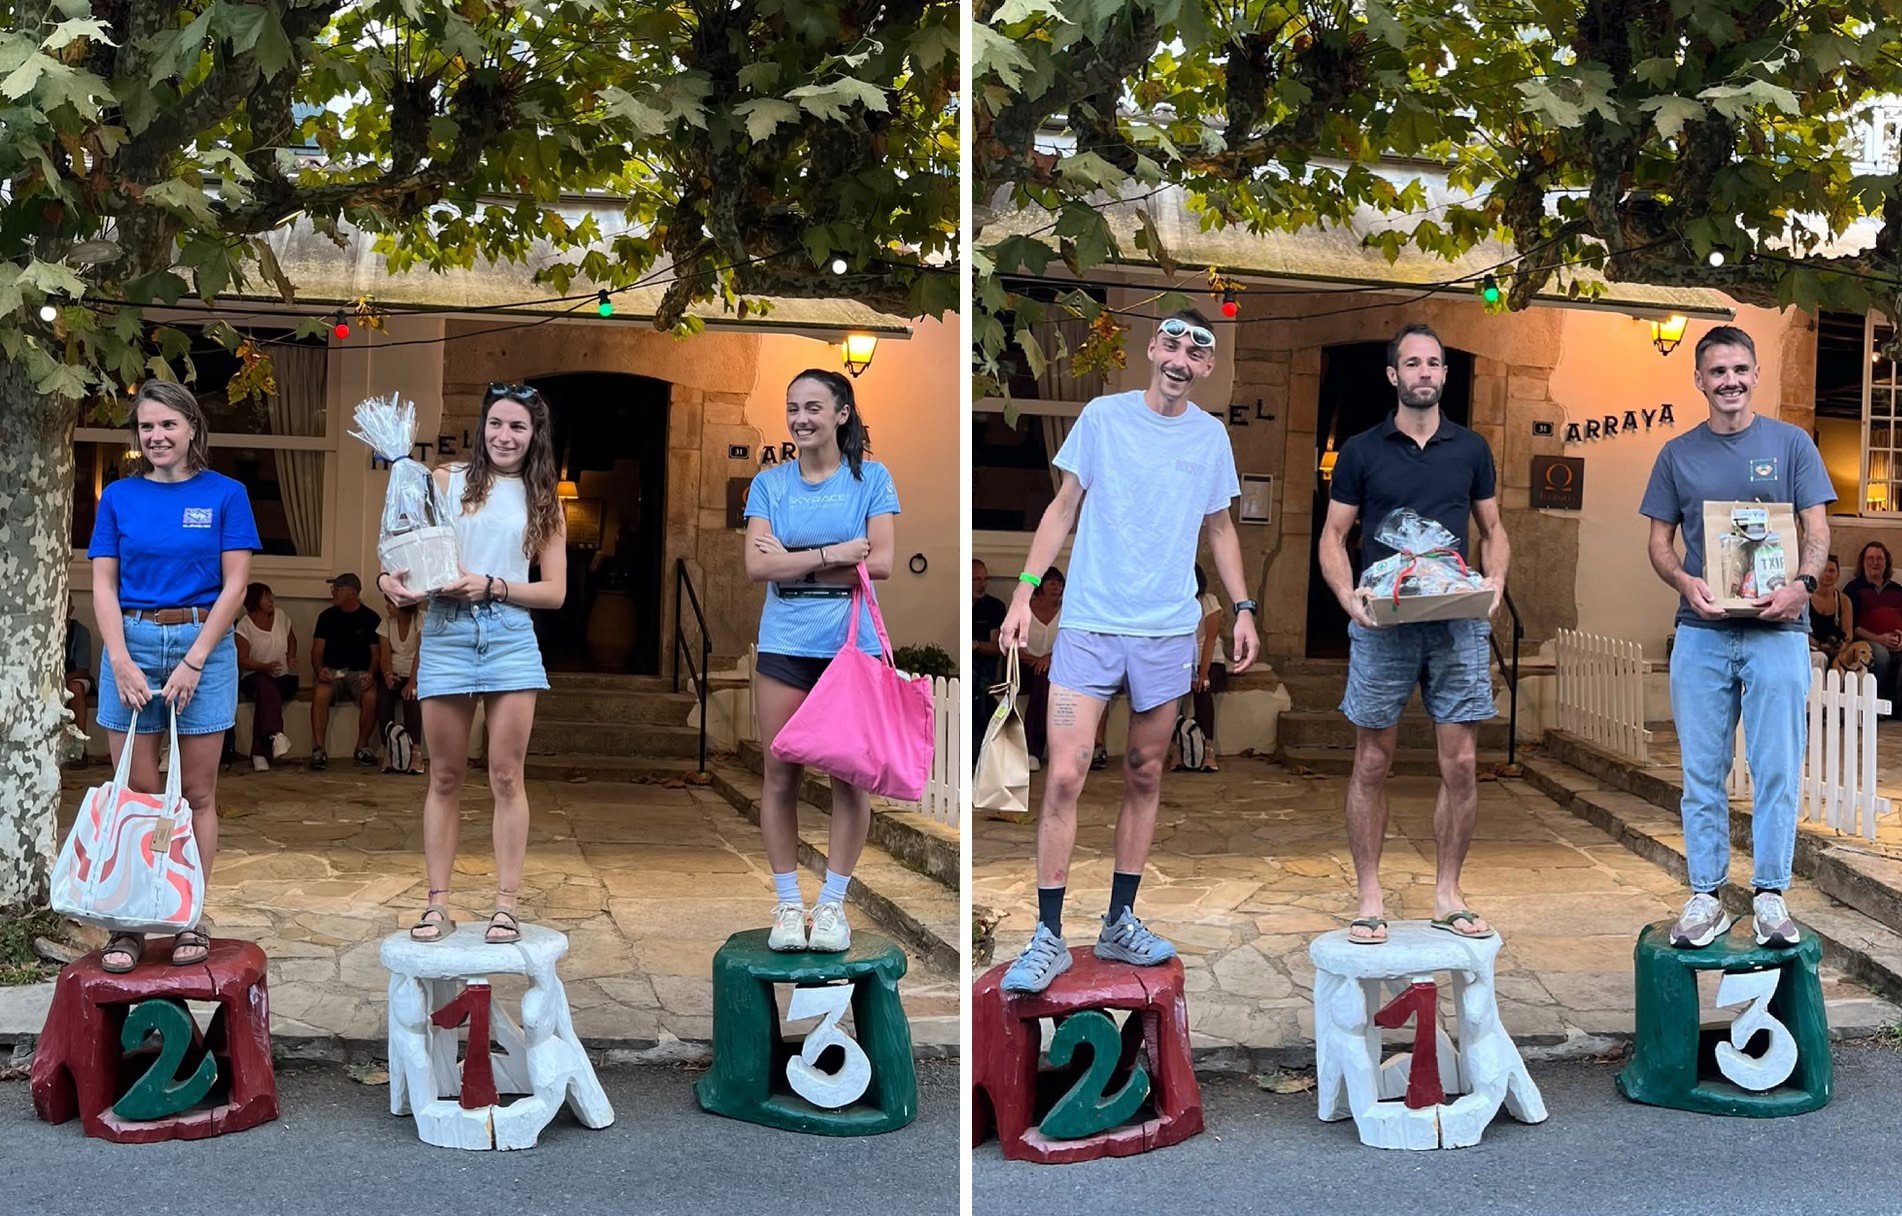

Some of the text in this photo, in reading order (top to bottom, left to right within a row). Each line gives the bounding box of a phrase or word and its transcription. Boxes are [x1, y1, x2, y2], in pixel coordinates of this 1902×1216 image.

[1566, 404, 1675, 442] ARRAYA
[111, 999, 218, 1120] 2
[431, 984, 500, 1109] 1
[786, 984, 872, 1108] 3
[1039, 1010, 1150, 1139] 2
[1374, 982, 1445, 1108] 1
[1714, 968, 1798, 1091] 3
